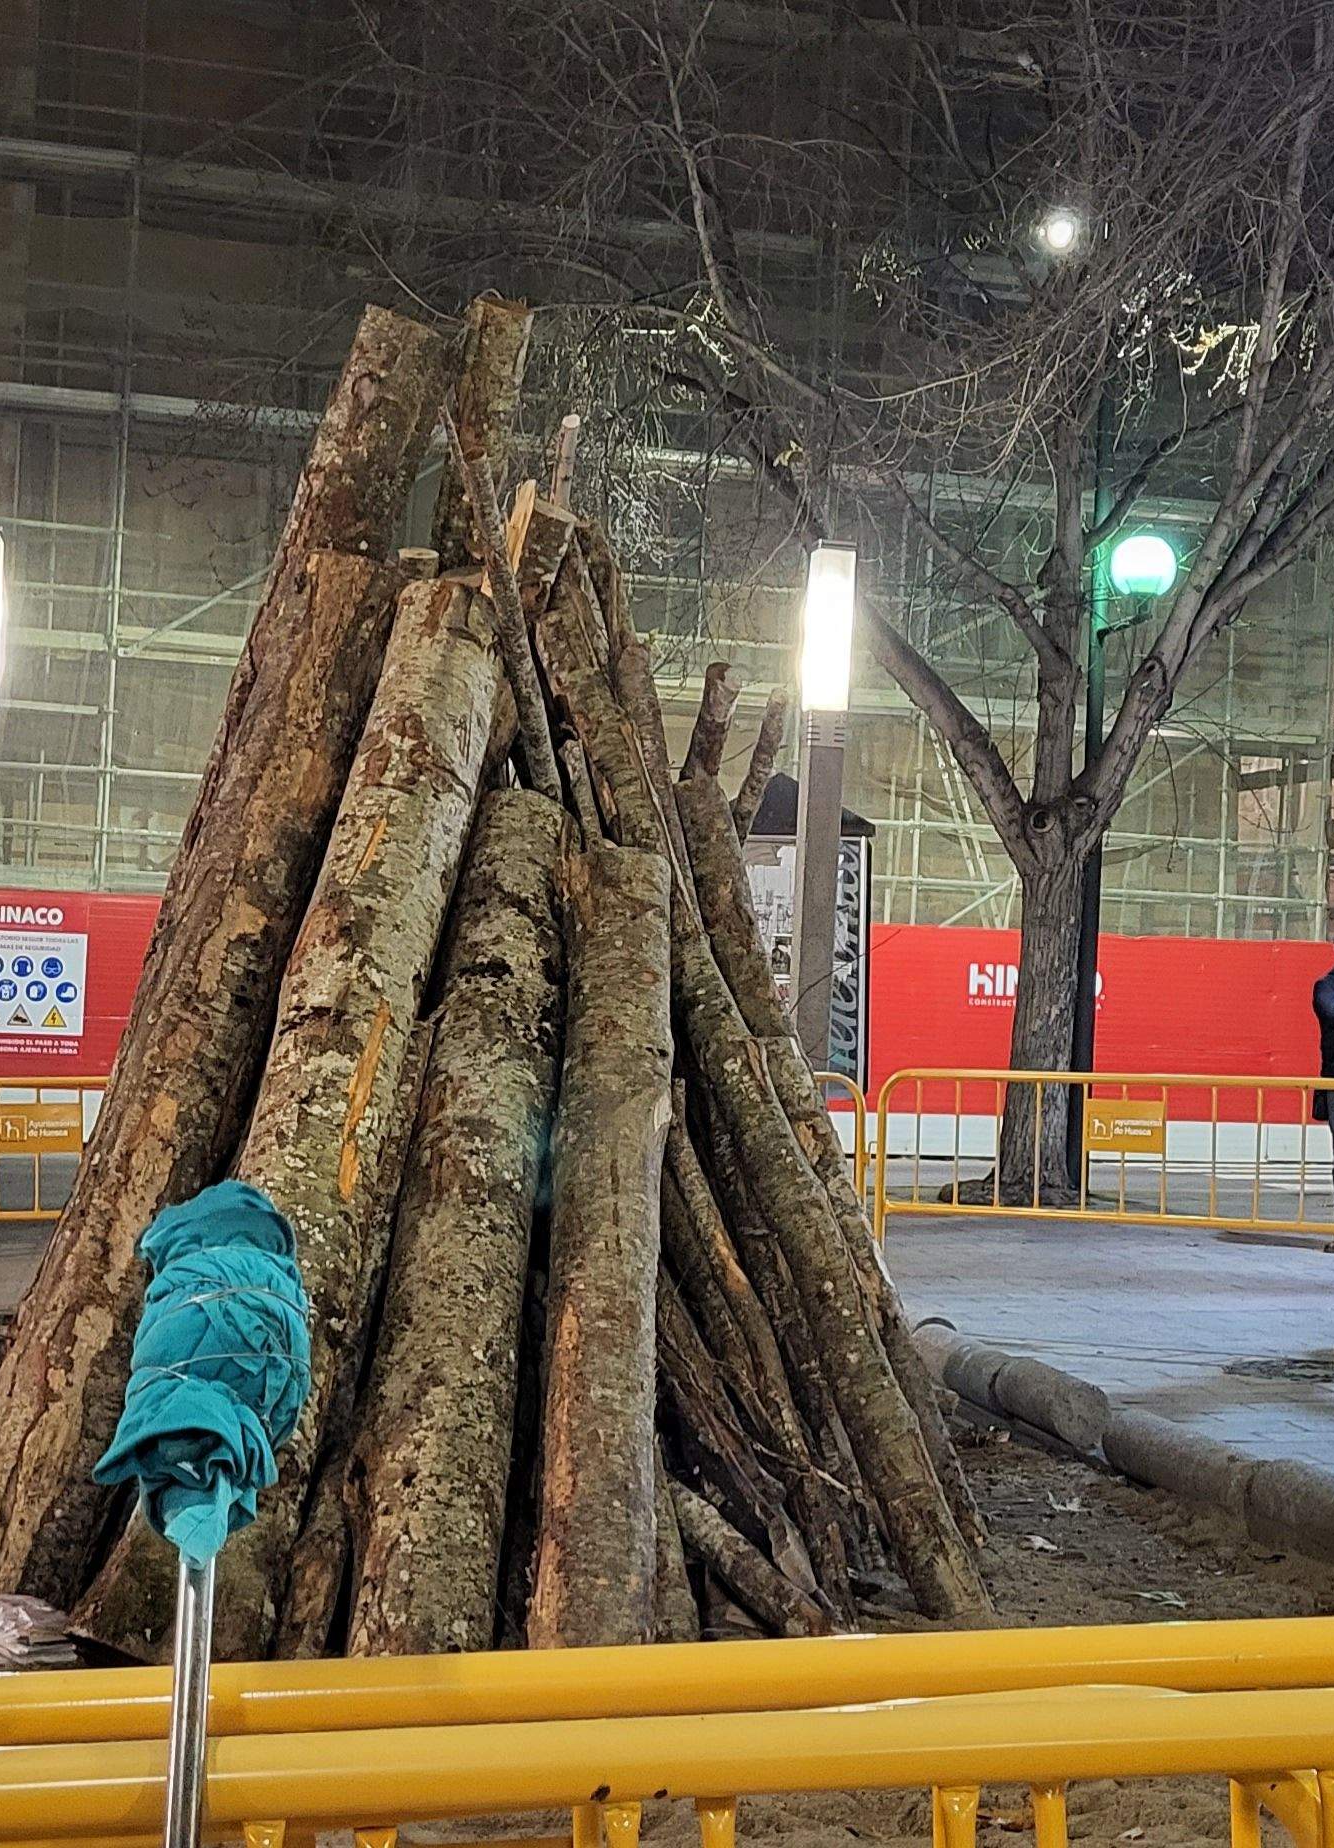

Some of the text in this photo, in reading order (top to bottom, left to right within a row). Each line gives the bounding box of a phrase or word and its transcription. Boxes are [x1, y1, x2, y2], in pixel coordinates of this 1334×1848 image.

[28, 1129, 68, 1137] de Huesca
[1113, 1127, 1152, 1136] de Huesca
